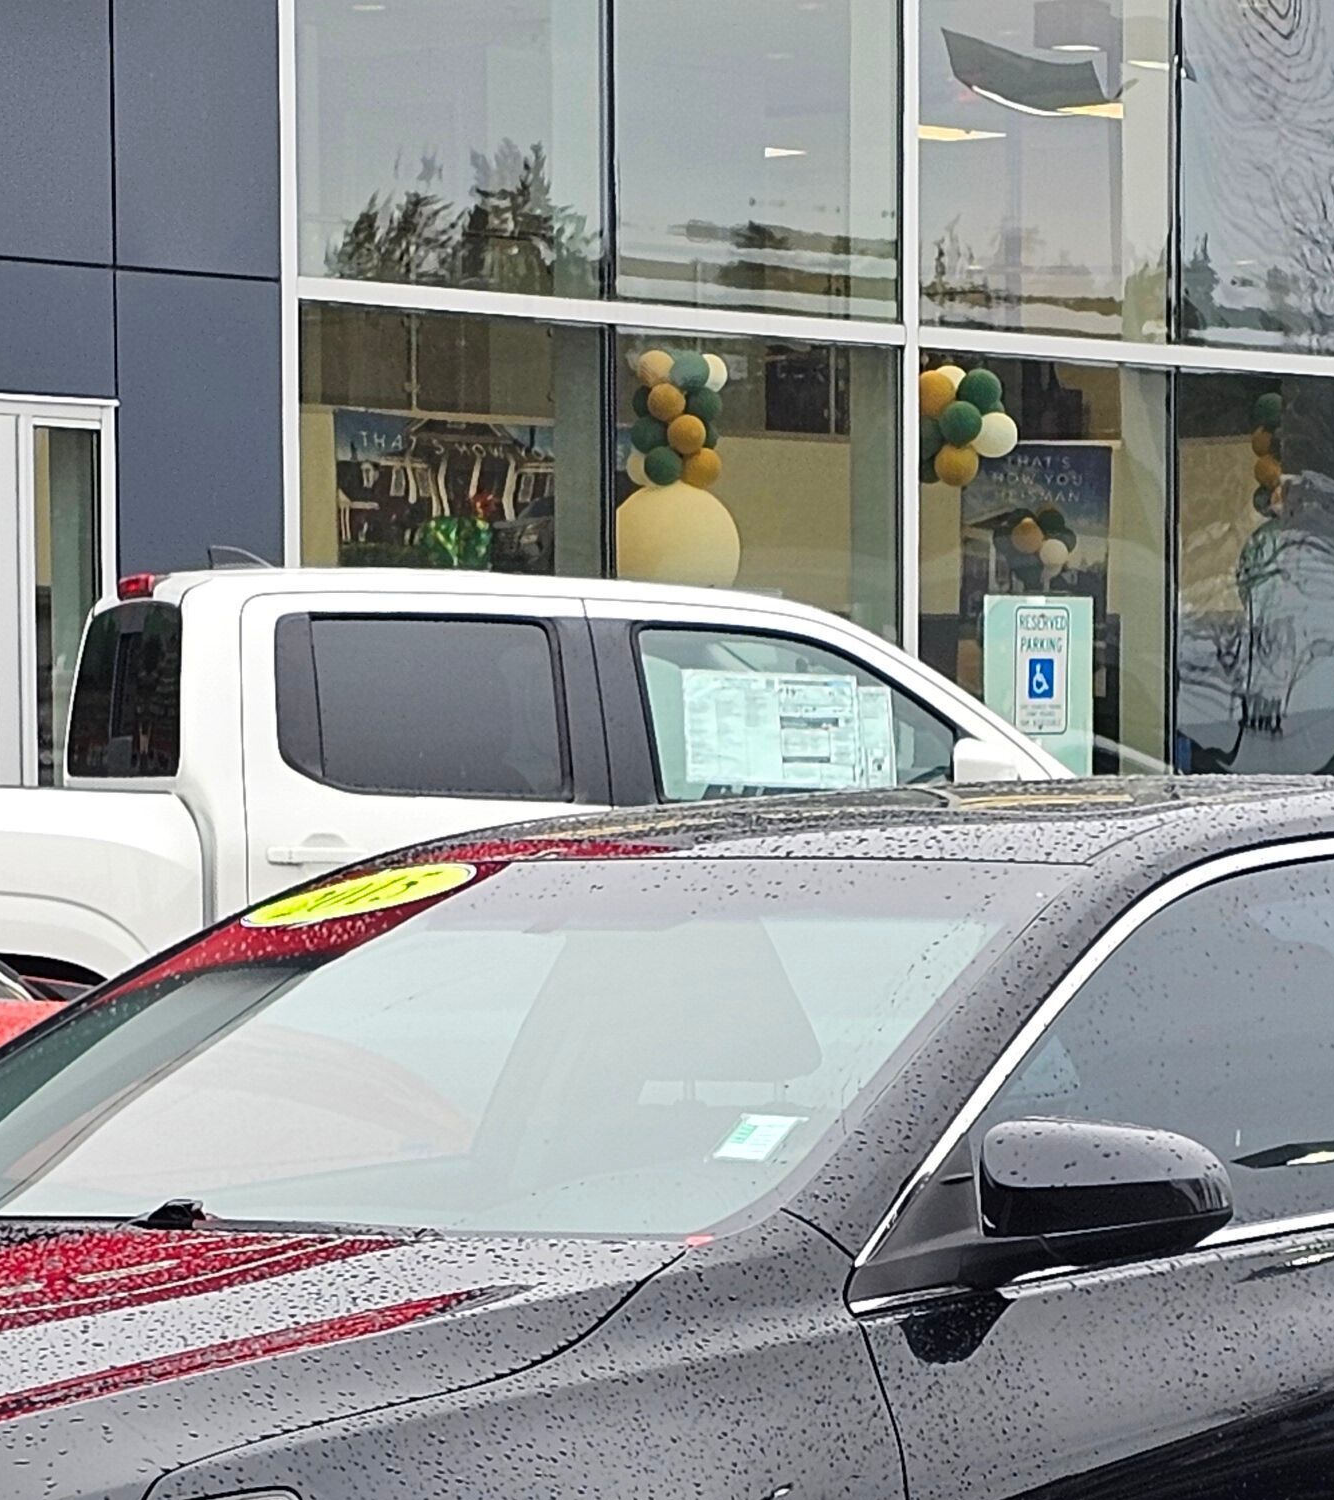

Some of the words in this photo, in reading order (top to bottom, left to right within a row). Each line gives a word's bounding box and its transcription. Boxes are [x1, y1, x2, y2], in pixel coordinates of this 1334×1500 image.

[992, 471, 1037, 485] HOW
[1044, 473, 1083, 487] YOU
[1018, 613, 1067, 631] RESERVED
[1020, 636, 1063, 653] PARKING
